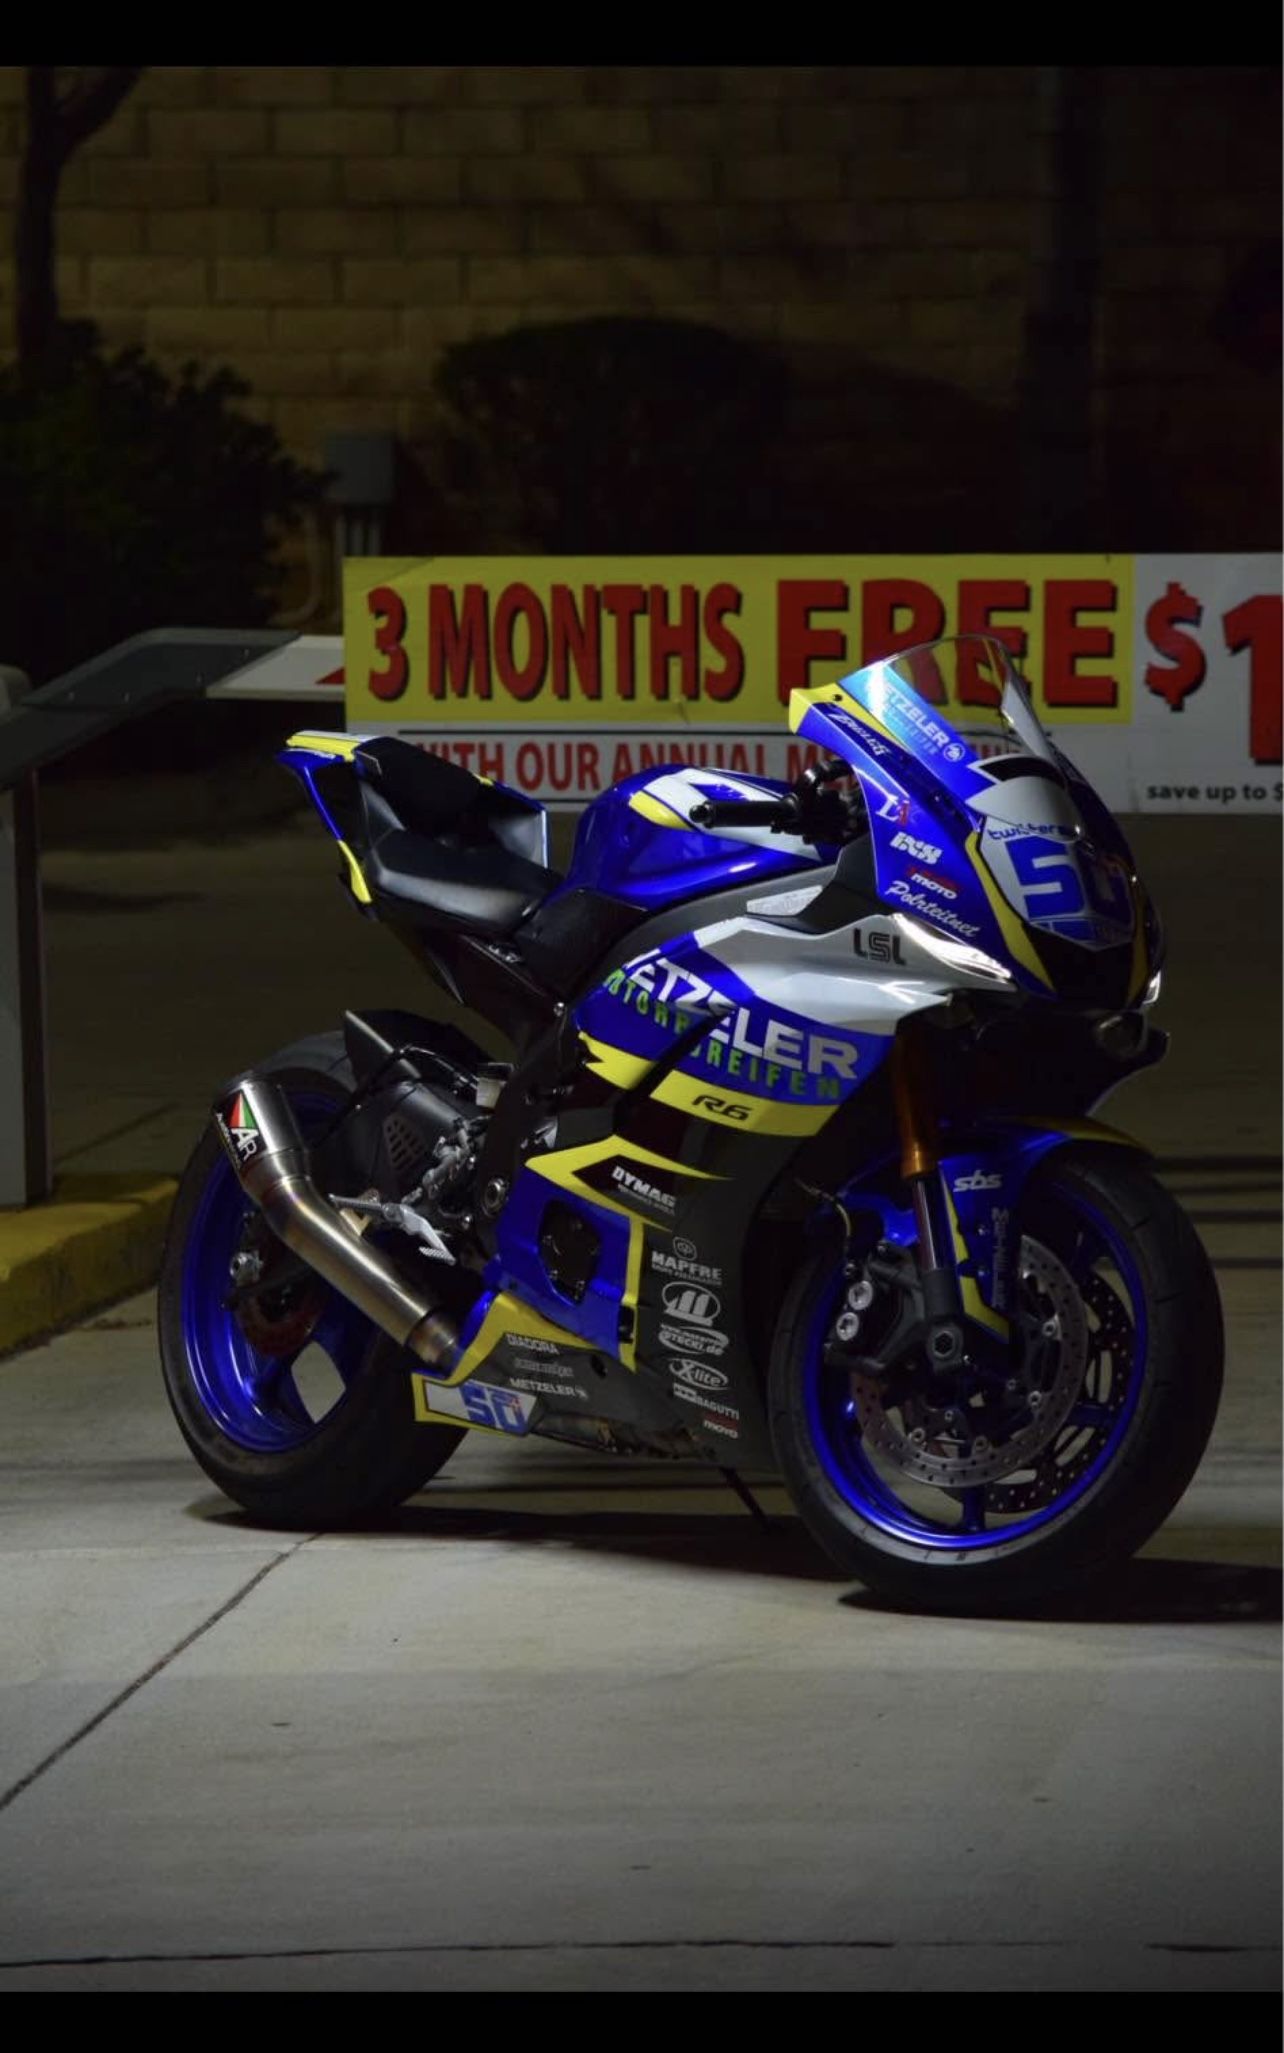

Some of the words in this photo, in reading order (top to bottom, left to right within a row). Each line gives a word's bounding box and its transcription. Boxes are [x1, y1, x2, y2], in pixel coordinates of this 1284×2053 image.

[367, 586, 409, 700] 3
[428, 581, 745, 701] MONTHS
[776, 579, 1117, 708] FREE
[515, 742, 599, 791] OUR
[1147, 785, 1200, 799] save
[1206, 785, 1236, 805] up
[1243, 783, 1267, 799] to
[853, 928, 907, 966] LSL
[691, 1093, 753, 1121] R6
[952, 1169, 1003, 1193] sbs
[459, 1380, 529, 1438] 50
